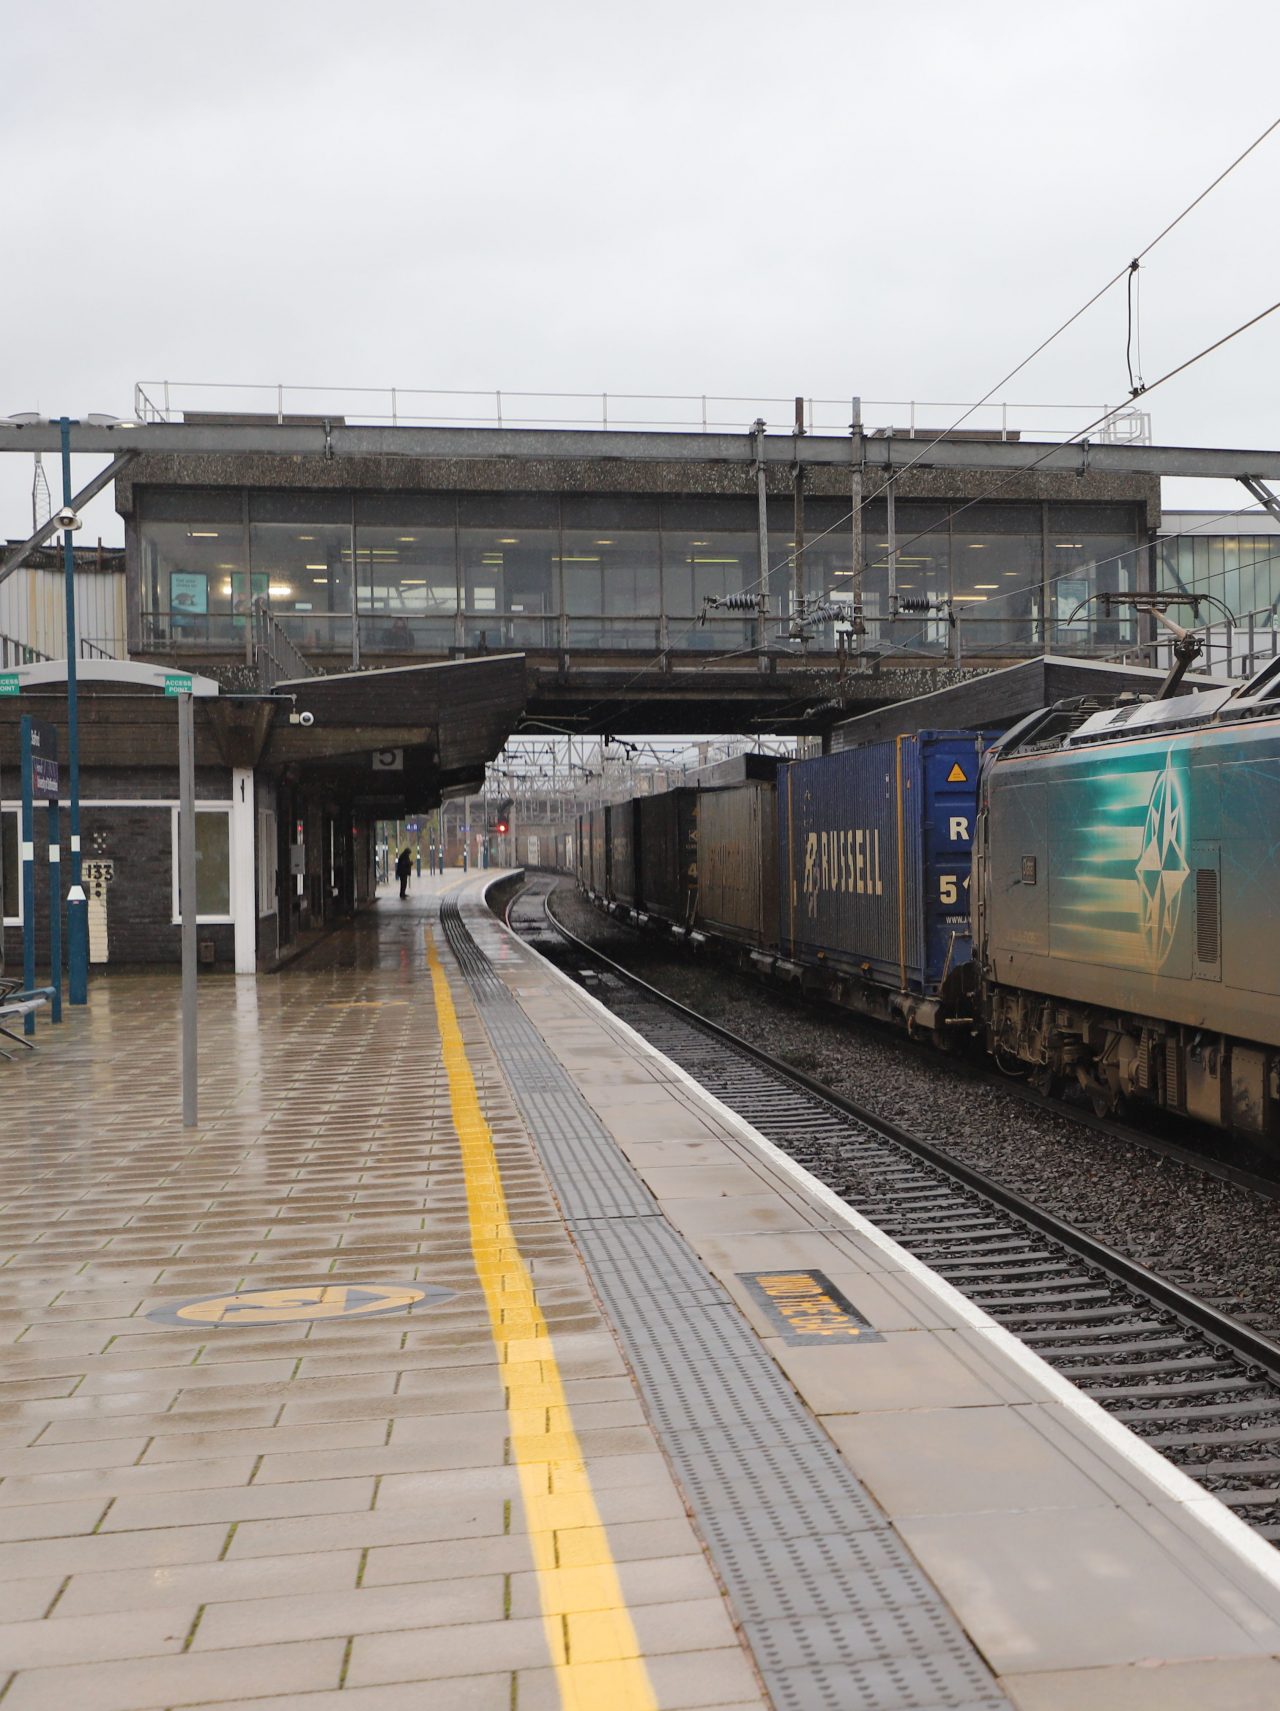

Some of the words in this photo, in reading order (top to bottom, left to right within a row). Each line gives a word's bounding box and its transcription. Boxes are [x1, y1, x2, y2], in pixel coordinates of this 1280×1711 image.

[87, 862, 114, 881] 133
[821, 829, 883, 896] RUSSELL
[755, 1274, 823, 1296] MIND
[772, 1295, 843, 1316] THE
[788, 1315, 861, 1336] GAP
